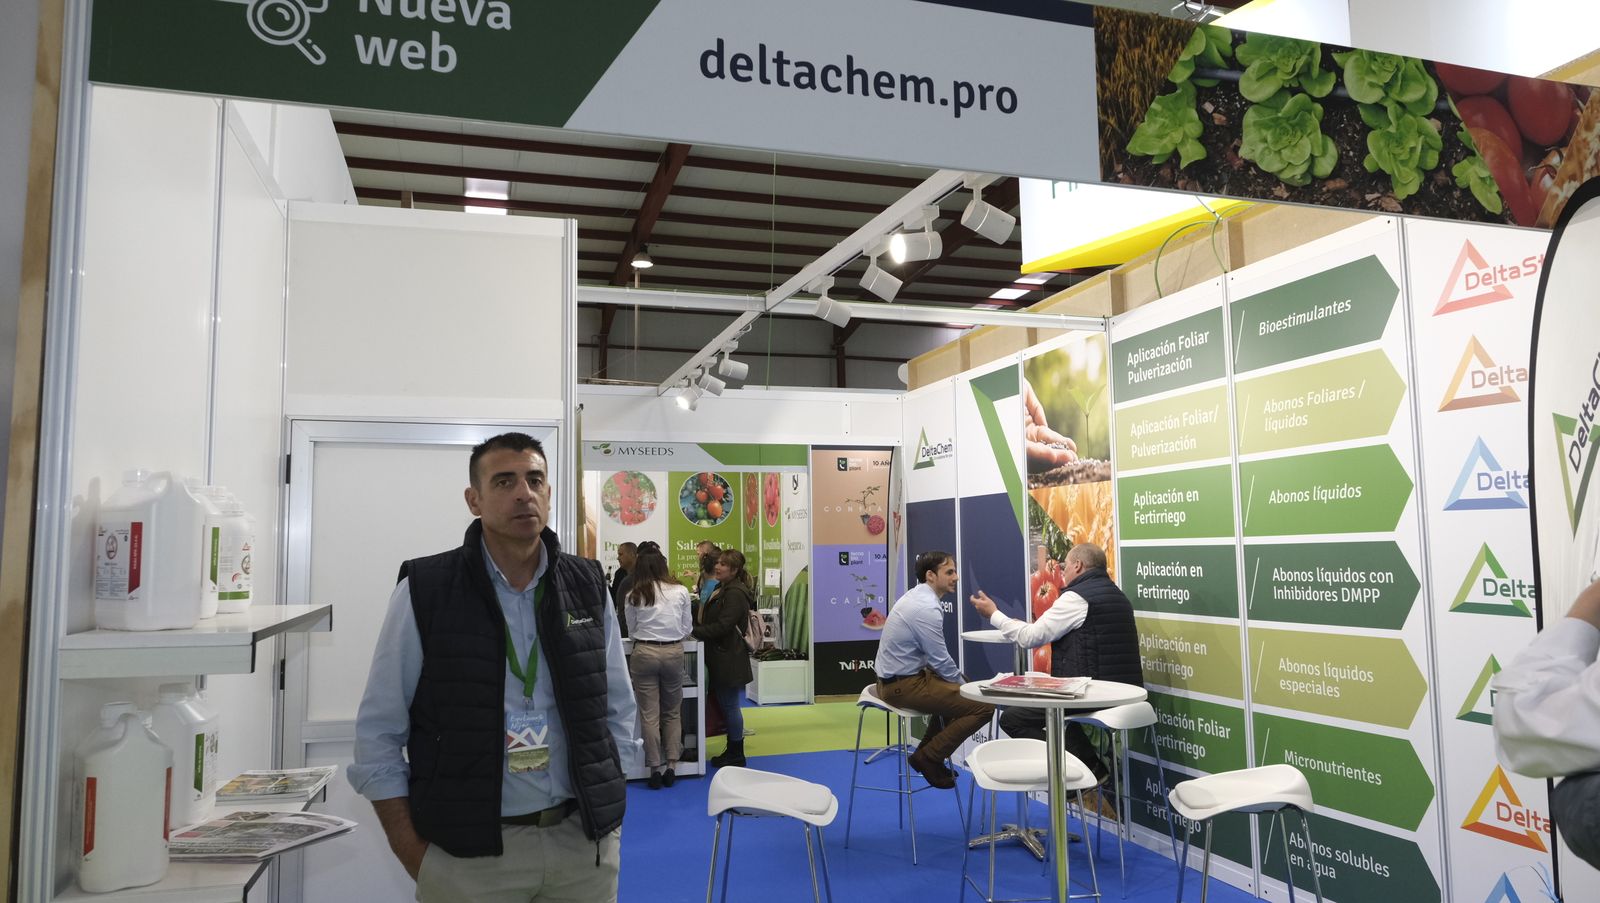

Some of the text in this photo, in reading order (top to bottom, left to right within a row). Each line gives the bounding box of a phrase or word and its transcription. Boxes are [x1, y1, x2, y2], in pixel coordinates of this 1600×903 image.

[358, 0, 512, 31] Nueva
[354, 30, 458, 73] web
[699, 37, 1019, 118] deltachem.pro
[1258, 299, 1352, 337] Bioestimulantes
[1126, 330, 1210, 367] Aplicación Foliar
[1127, 355, 1193, 385] Pulverización
[1471, 364, 1528, 389] Delta
[1263, 395, 1304, 415] Abonos
[1307, 386, 1356, 407] Foliares
[1130, 404, 1220, 438] Aplicación Foliar/
[1264, 413, 1308, 433] líquidos
[617, 446, 674, 457] MYSEEDS
[1130, 434, 1197, 459] Pulverización
[1133, 487, 1200, 508] Aplicación en
[1268, 483, 1362, 505] Abonos líquidos
[1134, 508, 1186, 527] Fertirriego
[1136, 561, 1203, 580] Aplicación en
[1272, 565, 1395, 586] Abonos líquidos con
[1137, 583, 1190, 605] Fertirriego
[1273, 584, 1381, 603] Inhibidores DMPP
[1482, 577, 1536, 599] Delta
[1139, 632, 1208, 655] Aplicación en
[1140, 655, 1194, 680] Fertirriego
[1278, 657, 1375, 683] Abonos líquidos
[1279, 677, 1341, 698] especiales
[1154, 707, 1232, 739] licación Foliar
[1284, 749, 1382, 786] Micronutrientes
[1146, 801, 1202, 835] Fertrriego
[1495, 800, 1551, 834] Delta
[1290, 853, 1304, 868] en
[1335, 849, 1390, 878] solubles
